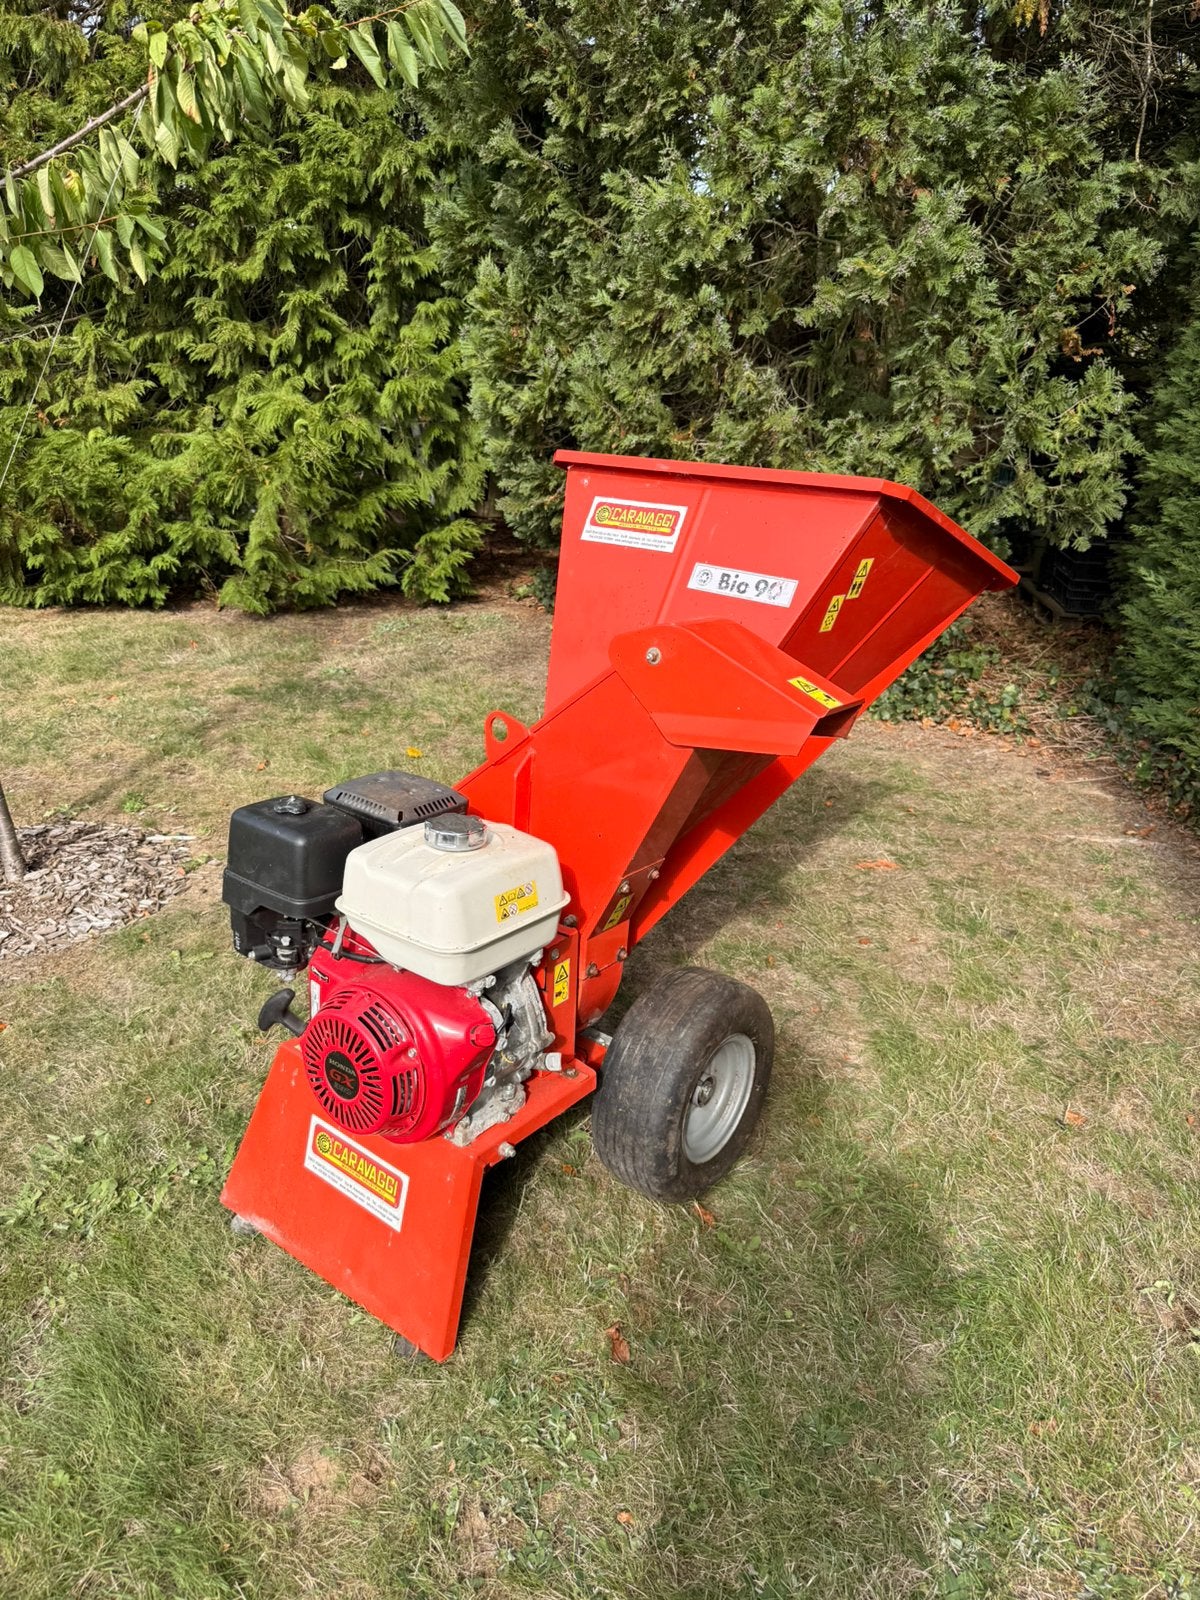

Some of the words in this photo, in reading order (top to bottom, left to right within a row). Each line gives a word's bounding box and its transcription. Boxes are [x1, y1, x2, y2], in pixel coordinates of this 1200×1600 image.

[611, 507, 676, 527] CARAVAGGI
[718, 572, 749, 594] Bio
[328, 1058, 357, 1077] HONDA
[330, 1068, 355, 1090] GX
[332, 1140, 398, 1196] CARAVAGGI
